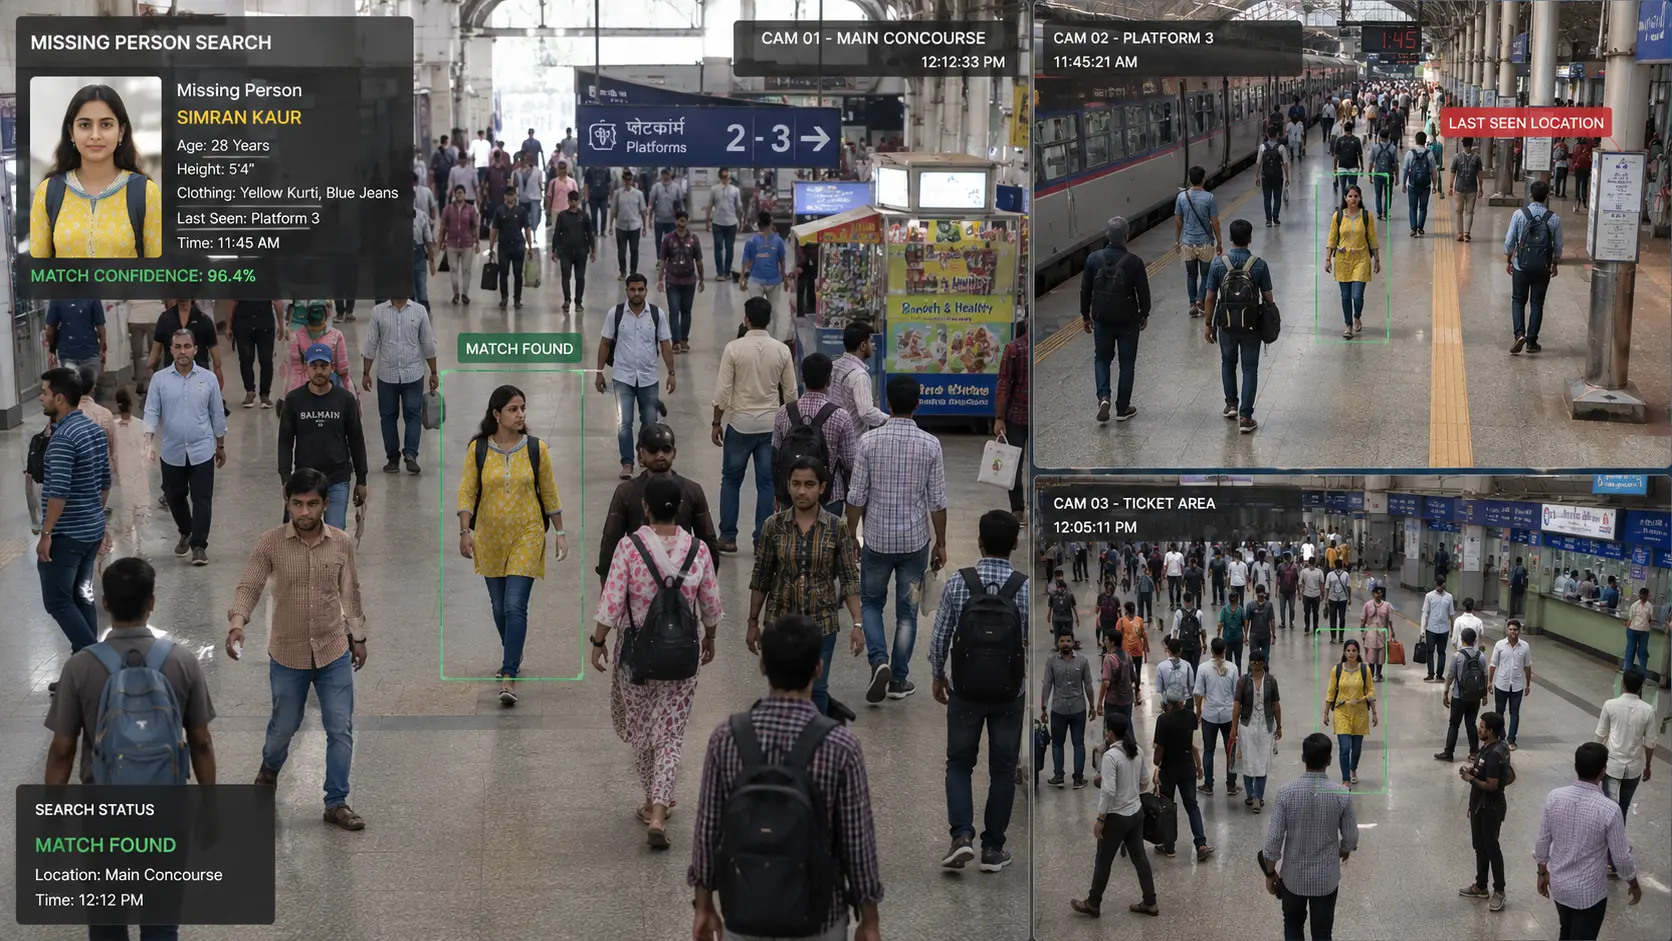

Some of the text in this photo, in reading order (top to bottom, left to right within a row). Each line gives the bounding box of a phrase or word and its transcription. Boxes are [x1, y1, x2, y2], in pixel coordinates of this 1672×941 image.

[726, 123, 746, 152] 2
[771, 123, 791, 153] 3
[626, 140, 687, 153] Platforms
[300, 411, 341, 419] BALMAIN
